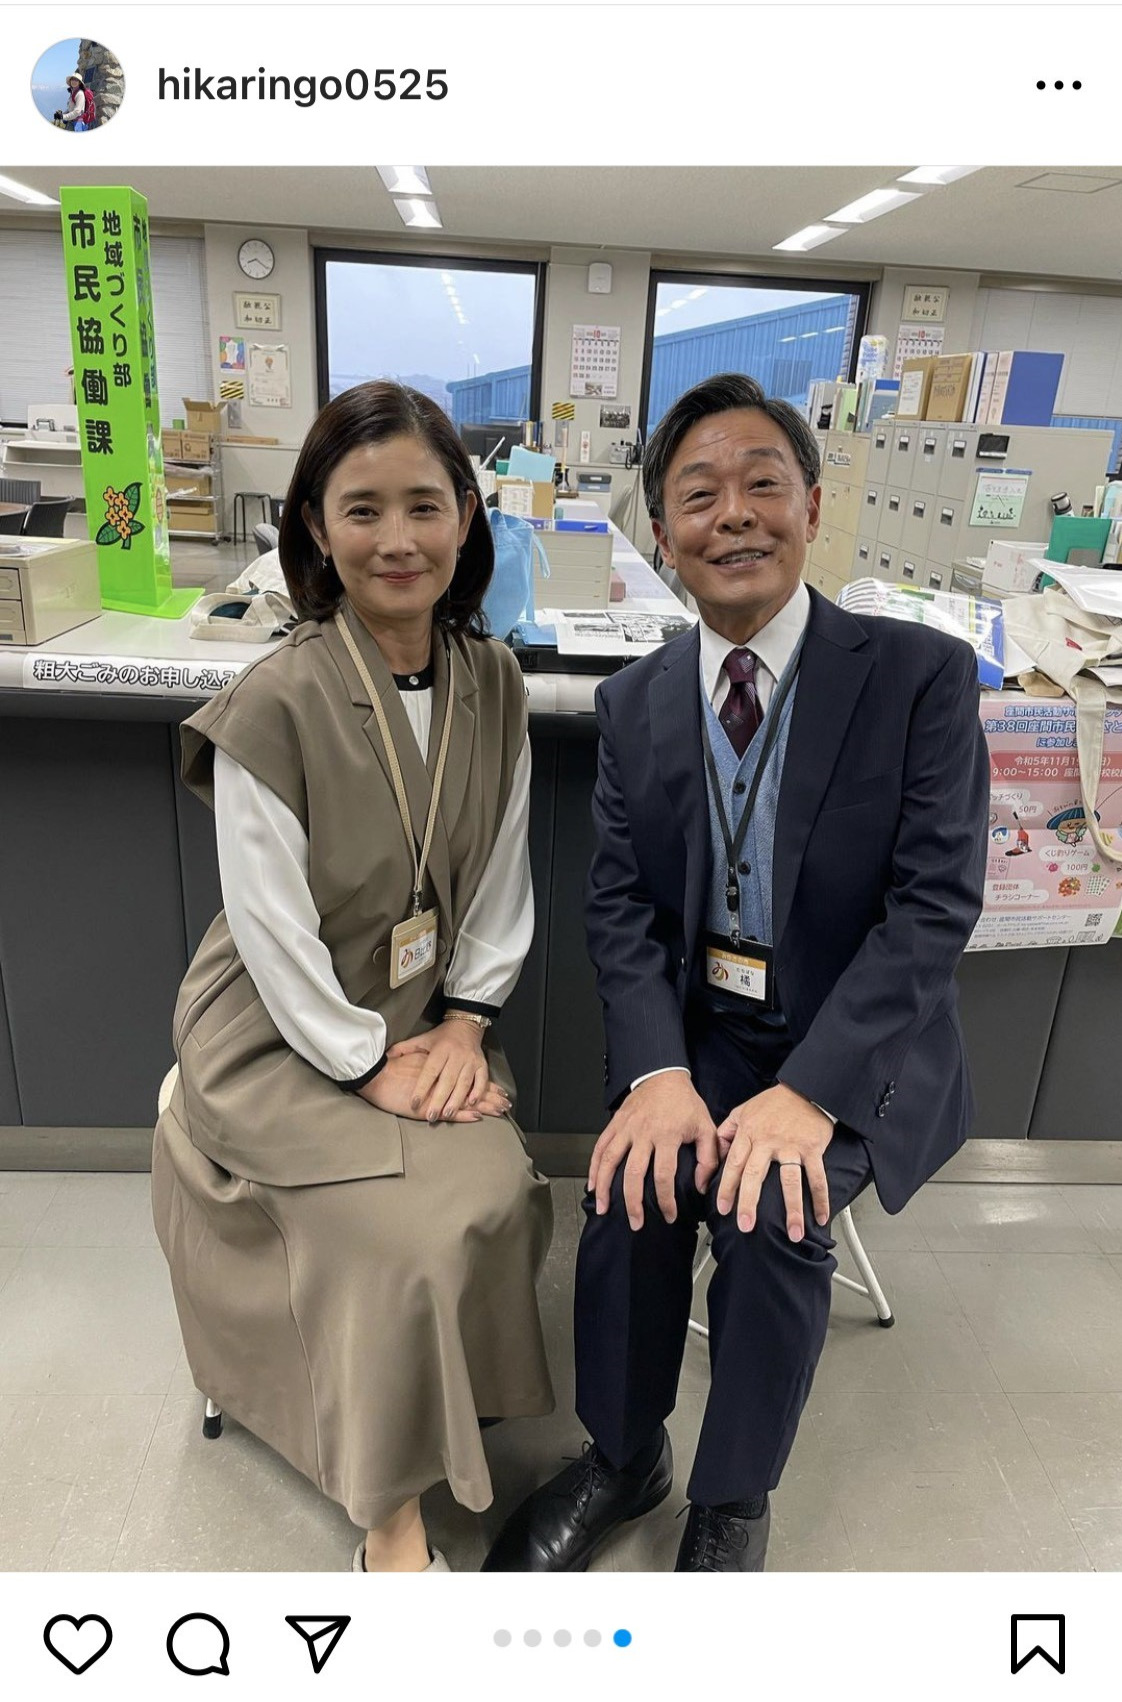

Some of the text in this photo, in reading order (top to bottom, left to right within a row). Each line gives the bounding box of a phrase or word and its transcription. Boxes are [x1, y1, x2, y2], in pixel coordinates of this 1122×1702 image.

[101, 209, 132, 388] 地域づくり部
[67, 209, 114, 455] 市民協働課
[984, 719, 1122, 733] 第38回座間市民さと
[990, 792, 1023, 801] ッチづくり
[1019, 805, 1037, 813] 50円
[1066, 863, 1088, 871] 100円
